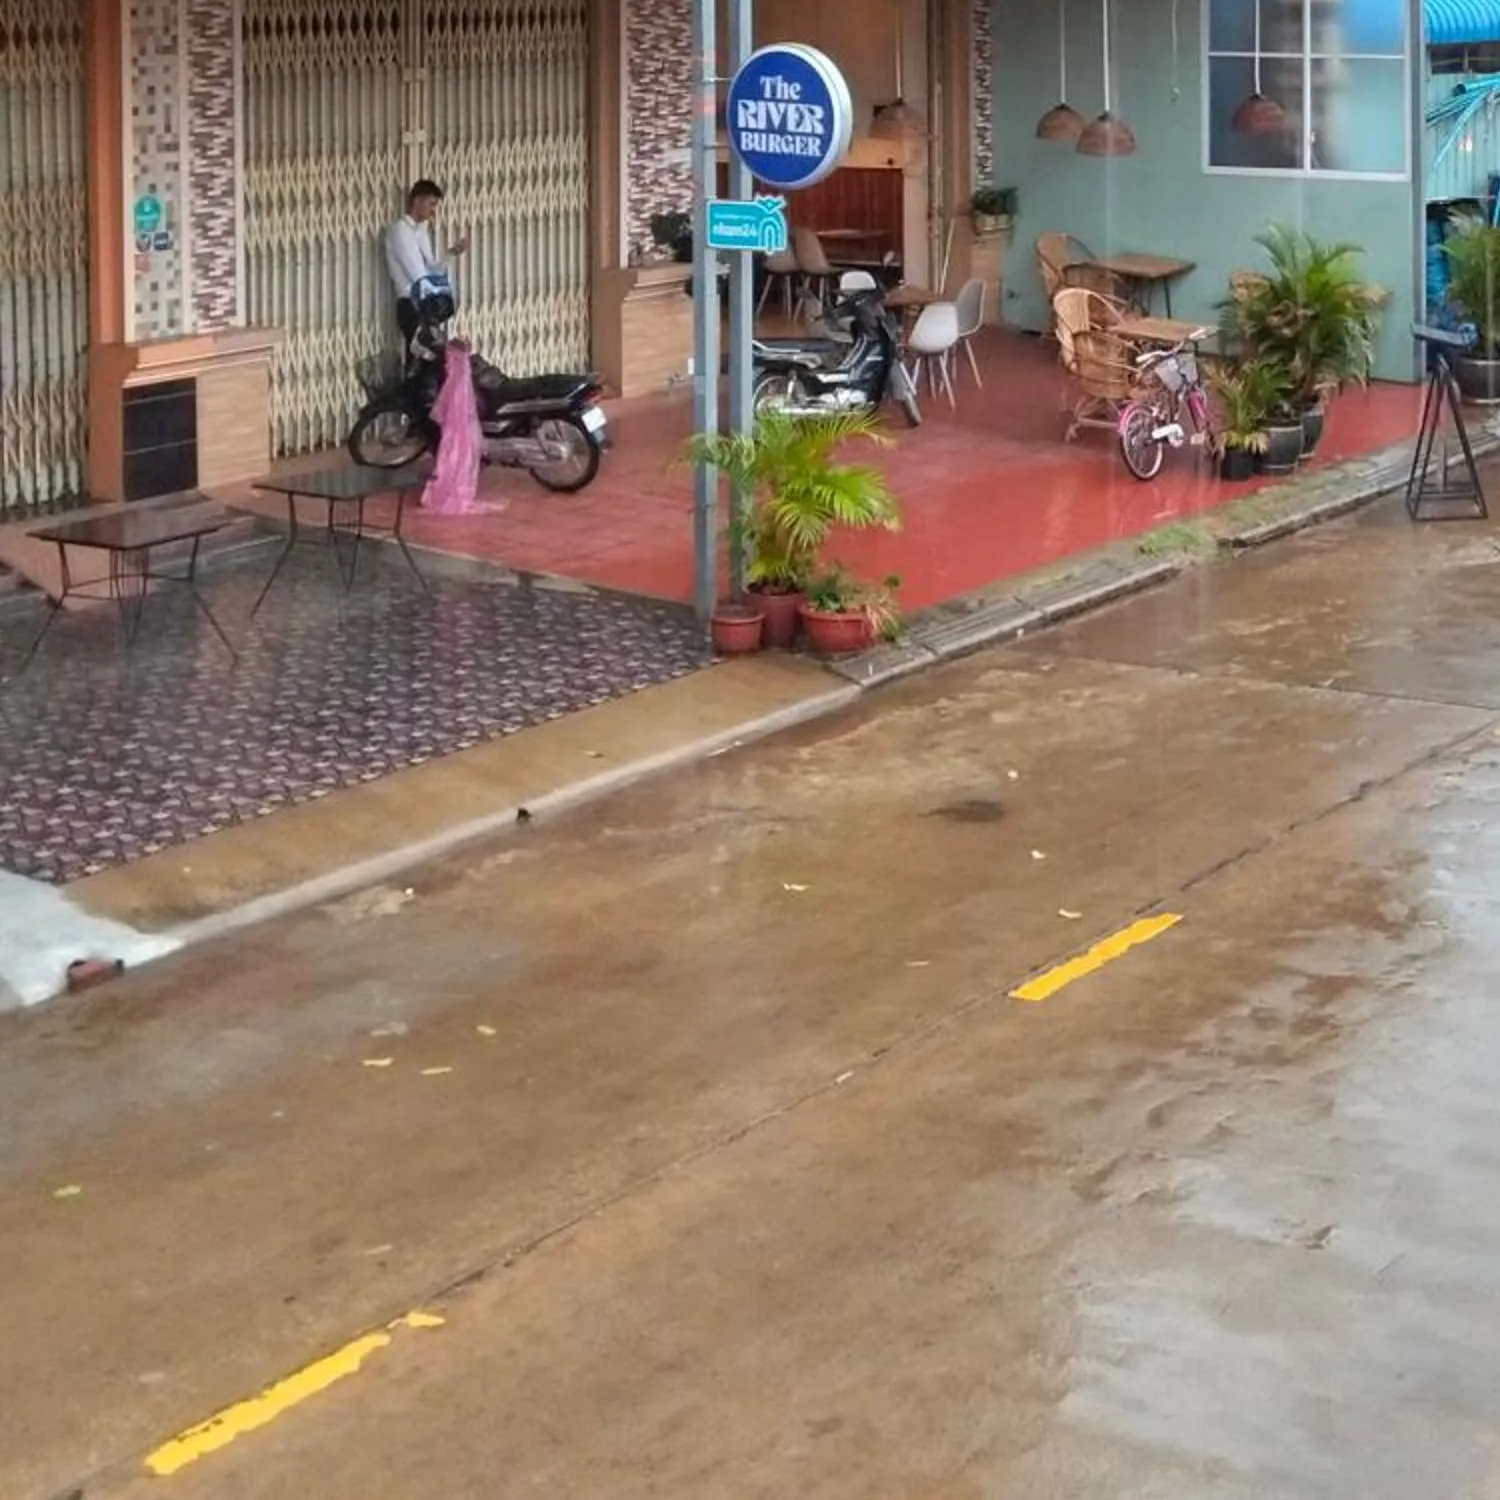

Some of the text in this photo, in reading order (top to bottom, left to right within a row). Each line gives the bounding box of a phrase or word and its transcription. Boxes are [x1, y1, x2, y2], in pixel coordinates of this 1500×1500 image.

[759, 75, 802, 100] The
[736, 99, 825, 135] RIVER
[740, 130, 822, 157] BURGER
